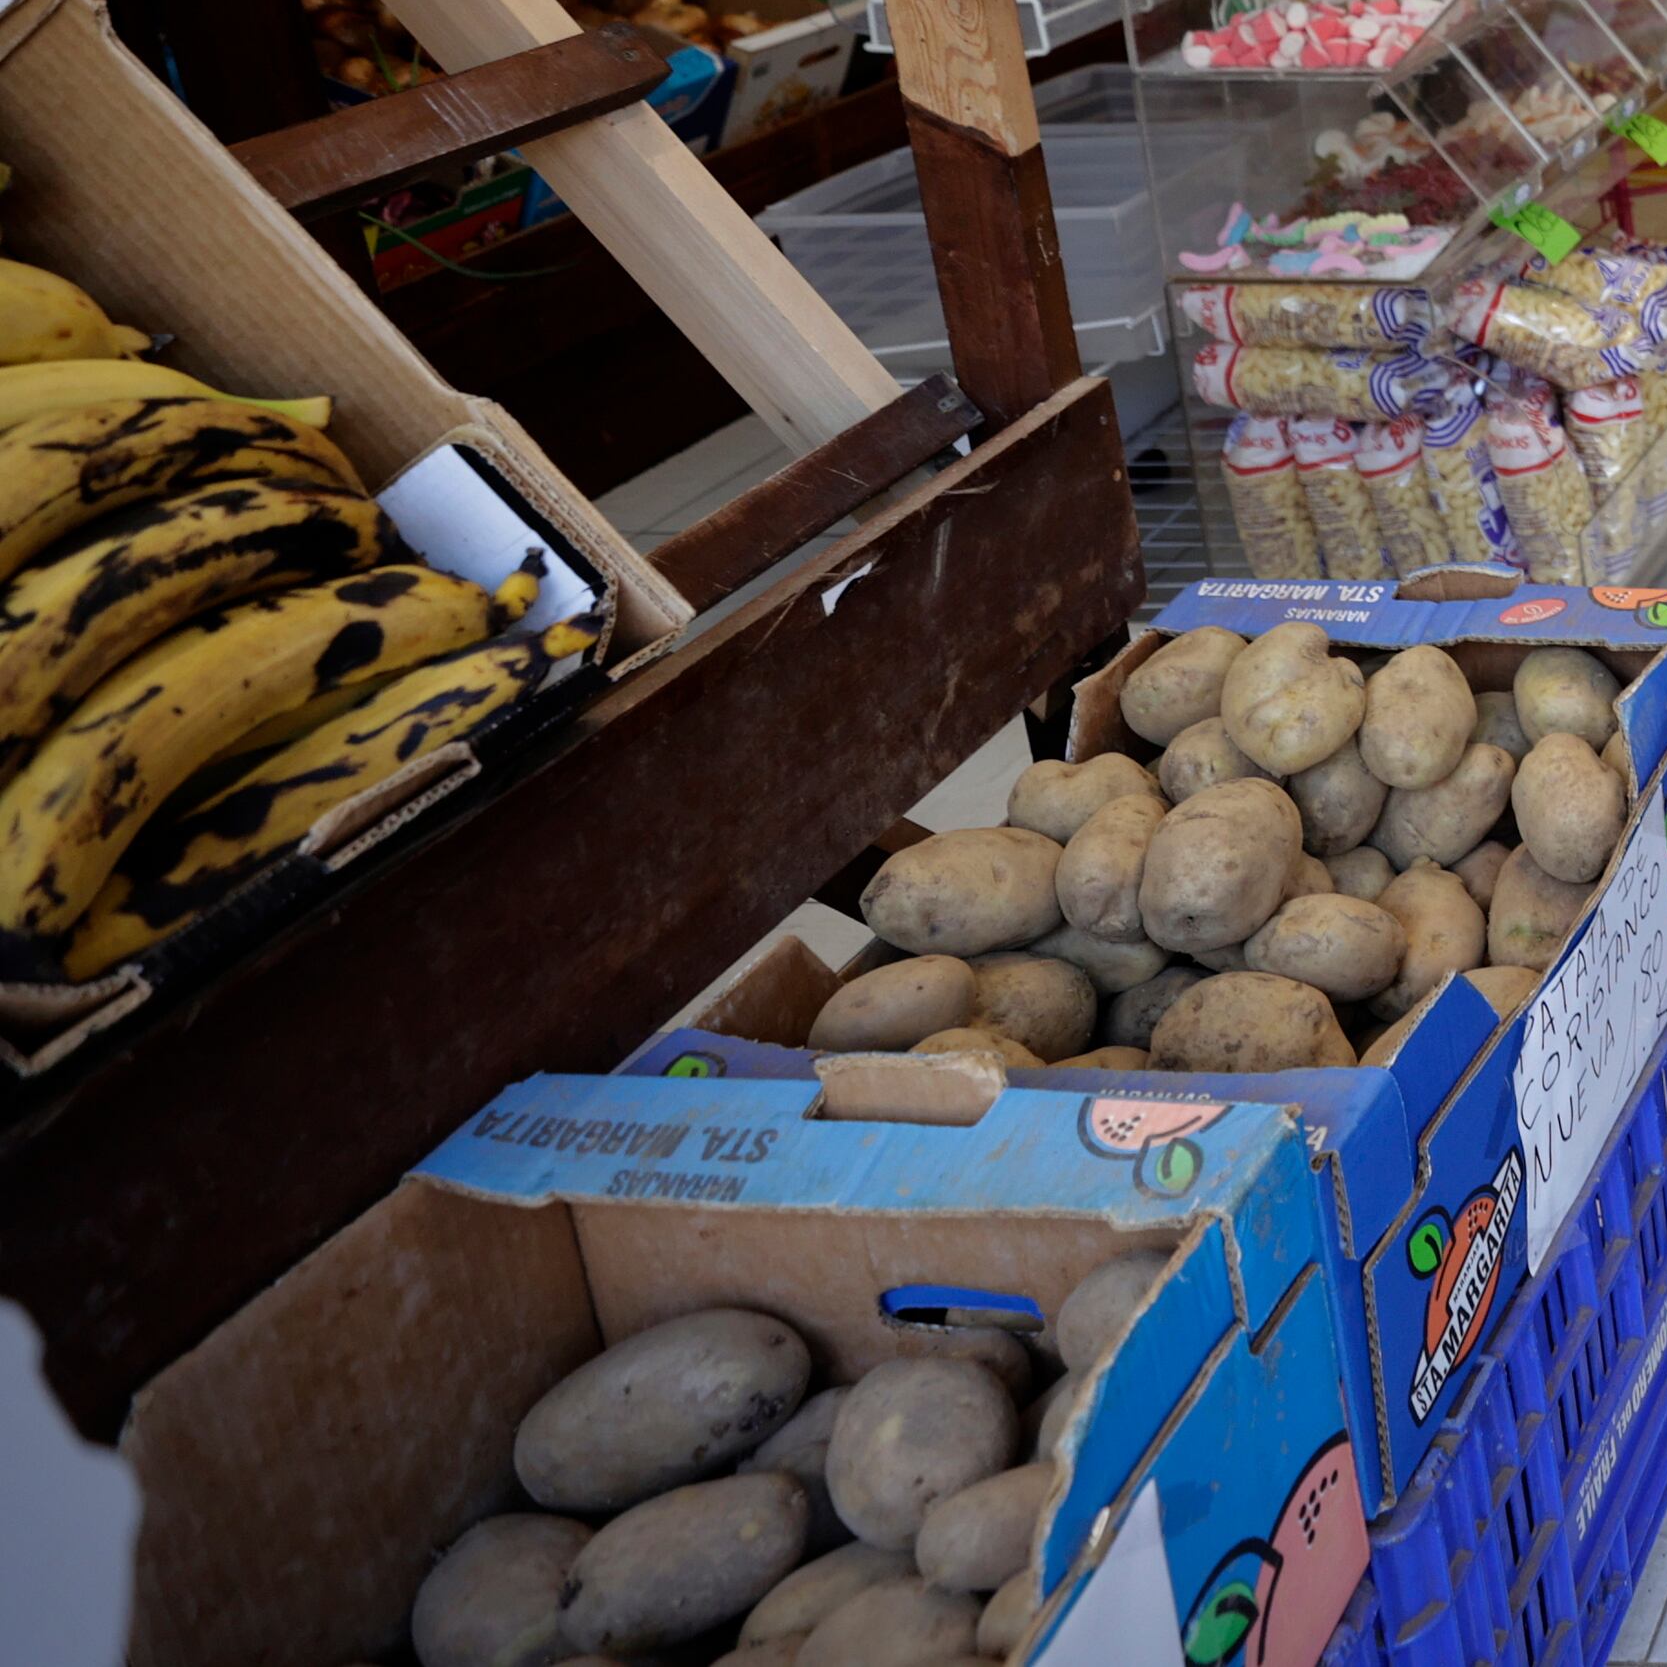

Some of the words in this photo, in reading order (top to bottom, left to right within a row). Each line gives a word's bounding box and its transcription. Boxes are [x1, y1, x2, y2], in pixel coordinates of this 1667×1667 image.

[1197, 581, 1331, 602] MARGARITA
[1336, 584, 1386, 603] STA.
[1284, 607, 1371, 623] NARANJAS
[1518, 907, 1609, 1076] PATATA
[1618, 837, 1648, 900] DE
[472, 1109, 690, 1160] MARGARITA
[1531, 1018, 1616, 1209] NUEVA
[700, 1126, 779, 1164] STA.
[606, 1169, 749, 1201] NARANJAS
[1419, 1362, 1451, 1413] STA.
[1441, 1164, 1520, 1366] MARGARITA
[1452, 1243, 1482, 1301] NARANJAS
[1615, 1407, 1634, 1438] DEL
[1575, 1438, 1619, 1542] FRAILE
